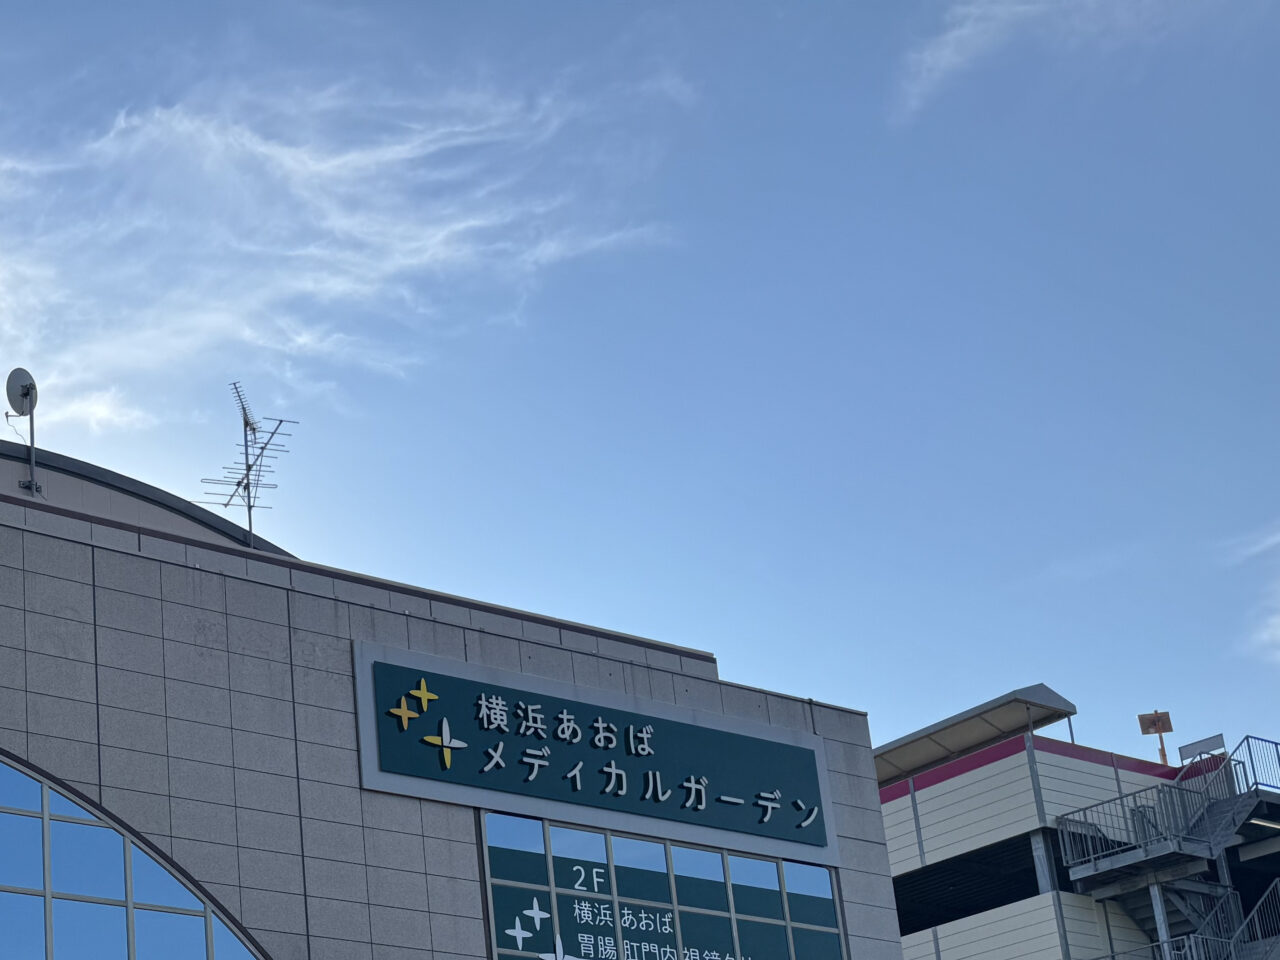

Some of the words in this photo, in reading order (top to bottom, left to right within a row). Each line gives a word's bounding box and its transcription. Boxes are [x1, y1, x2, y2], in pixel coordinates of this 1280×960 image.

[478, 693, 655, 757] 横浜あおば
[483, 741, 819, 829] メディカルガーデン
[572, 865, 605, 893] 2F
[572, 899, 674, 934] 横浜あおば
